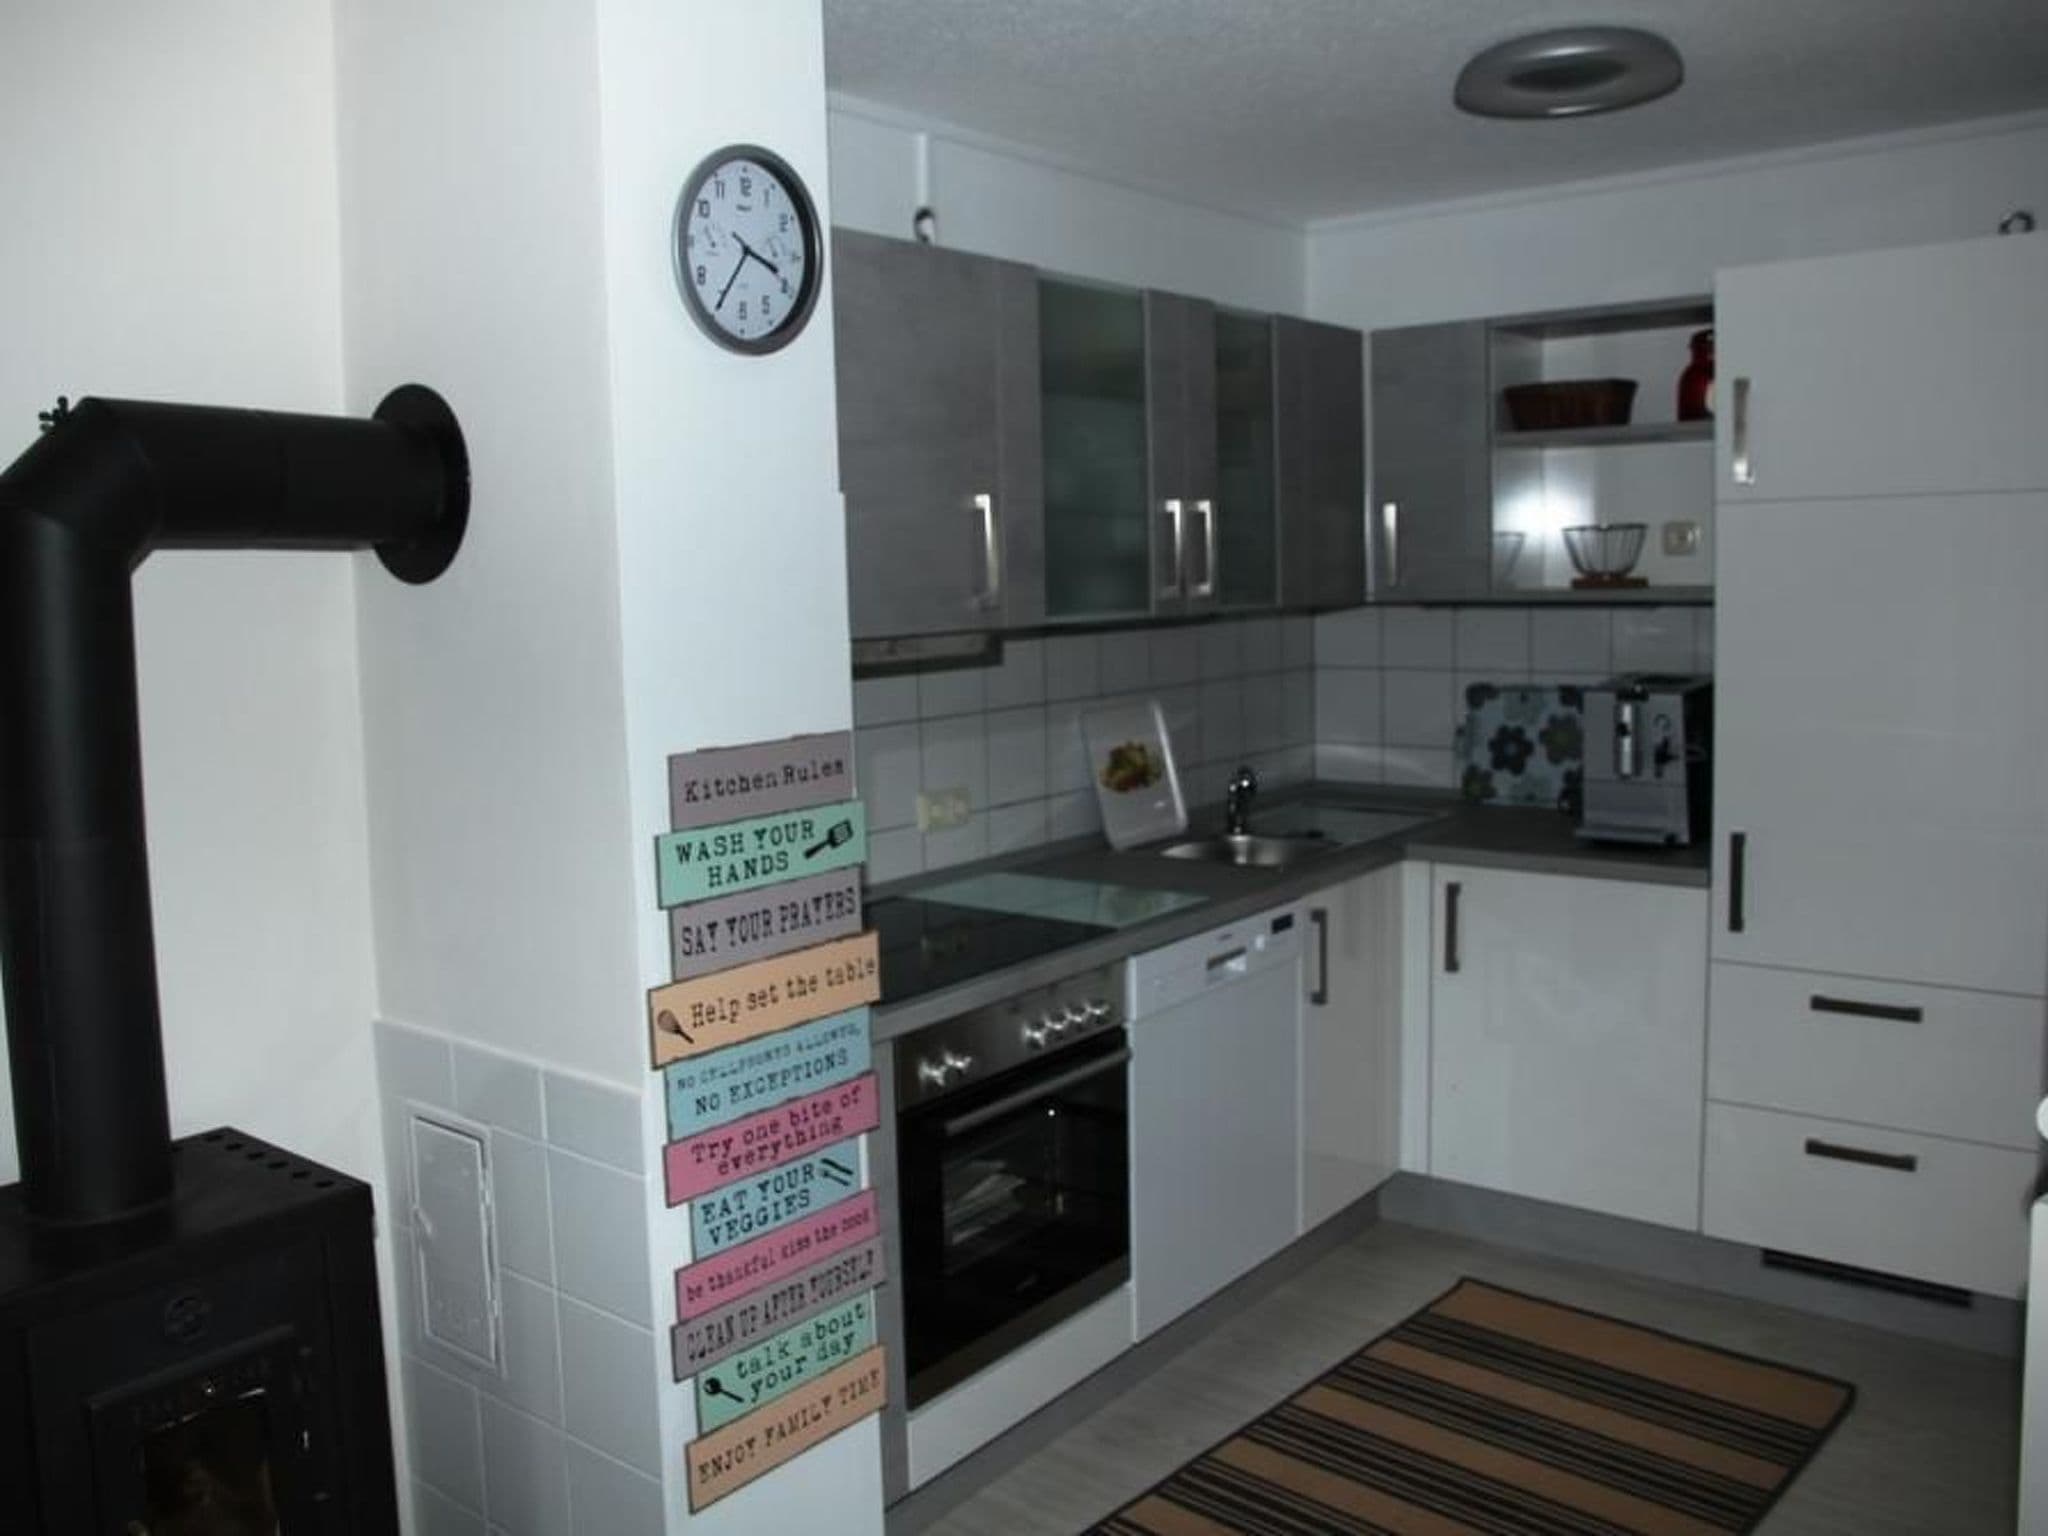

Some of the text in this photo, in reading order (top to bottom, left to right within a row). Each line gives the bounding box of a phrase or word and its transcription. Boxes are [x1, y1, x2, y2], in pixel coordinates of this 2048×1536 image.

[697, 265, 706, 286] 8
[762, 295, 770, 315] 5
[739, 301, 747, 320] 6
[684, 758, 844, 803] Kitchen Rules
[675, 820, 815, 865] WASH YOUR
[707, 851, 789, 888] HANDS
[682, 887, 856, 957] SAY YOUR PRAYERS
[691, 957, 876, 1029] Help set the table
[677, 1076, 696, 1090] NO
[695, 1048, 848, 1116] NO EXCEPTIONS
[691, 1085, 861, 1165] Try one bite of
[718, 1117, 843, 1175] everything
[701, 1162, 815, 1225] EAT YOUR
[708, 1189, 811, 1246] VEGGIES
[686, 1285, 701, 1301] be
[707, 1252, 775, 1291] thankful
[815, 1223, 838, 1243] the
[687, 1250, 874, 1361] CLEAN UP AFTER YOURSELF
[736, 1302, 866, 1379] talk about
[750, 1331, 855, 1403] your day
[698, 1369, 880, 1485] ENJOY FAMILY TIME
